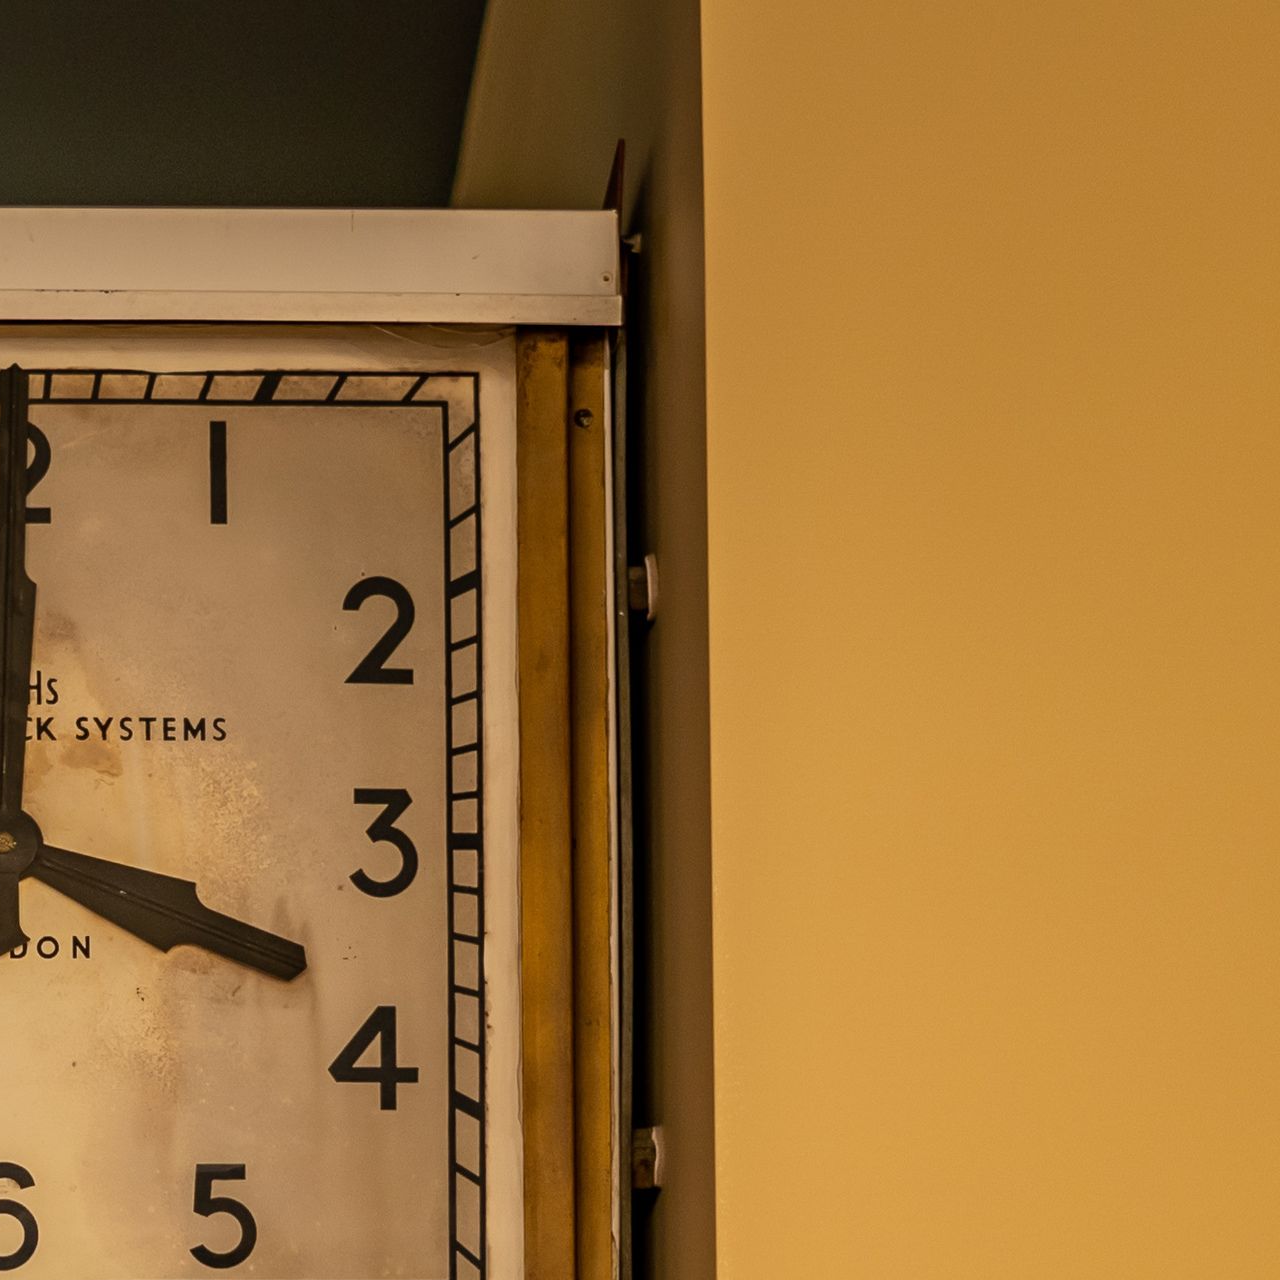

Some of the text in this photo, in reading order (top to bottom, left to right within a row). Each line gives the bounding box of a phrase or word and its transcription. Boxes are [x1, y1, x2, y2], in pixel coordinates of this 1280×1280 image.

[209, 420, 228, 525] 1
[342, 575, 416, 685] 2
[75, 716, 228, 742] SYSTEMS
[349, 787, 419, 898] 3
[327, 1005, 419, 1111] 4
[189, 1163, 258, 1269] 5
